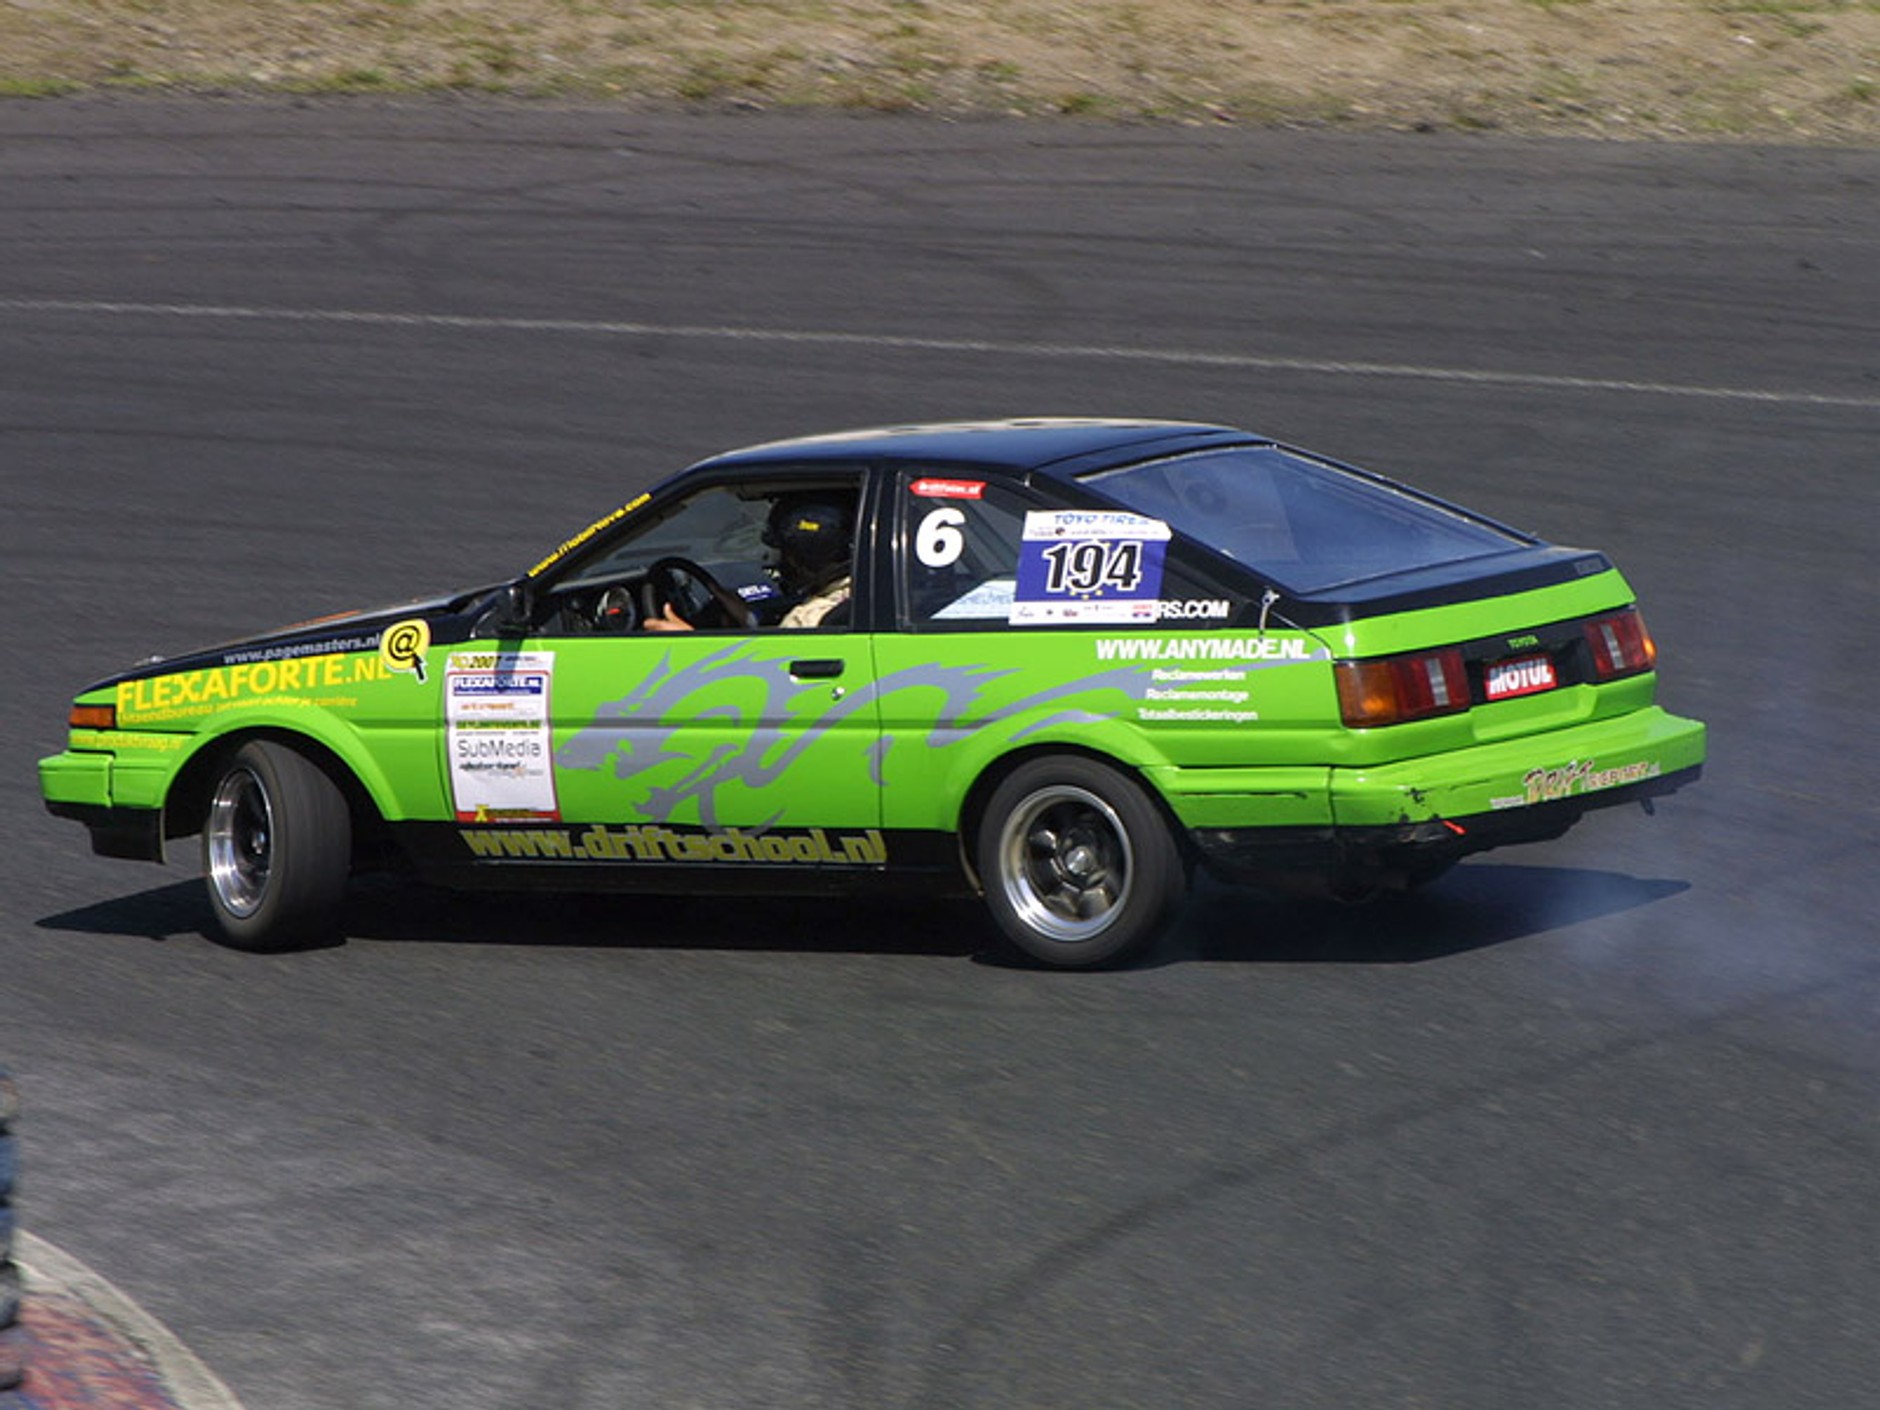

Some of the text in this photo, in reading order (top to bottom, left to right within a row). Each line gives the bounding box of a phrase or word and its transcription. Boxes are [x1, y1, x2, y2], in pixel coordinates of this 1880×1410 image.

[1055, 513, 1098, 525] TOYO
[916, 507, 966, 567] 6
[1043, 540, 1143, 592] 194
[224, 633, 380, 664] www.pagemasters.nl
[1096, 639, 1311, 660] WWW.ANYMADE.NL
[1507, 635, 1539, 649] TOYOTA
[116, 653, 394, 712] FLEXAFORTE.NL
[1151, 668, 1246, 680] Reclamewerken
[1489, 658, 1553, 694] MOTUL
[1146, 688, 1249, 703] Reclamemontage
[457, 739, 541, 757] SubMedia
[459, 825, 888, 865] www.driftschool.nl
